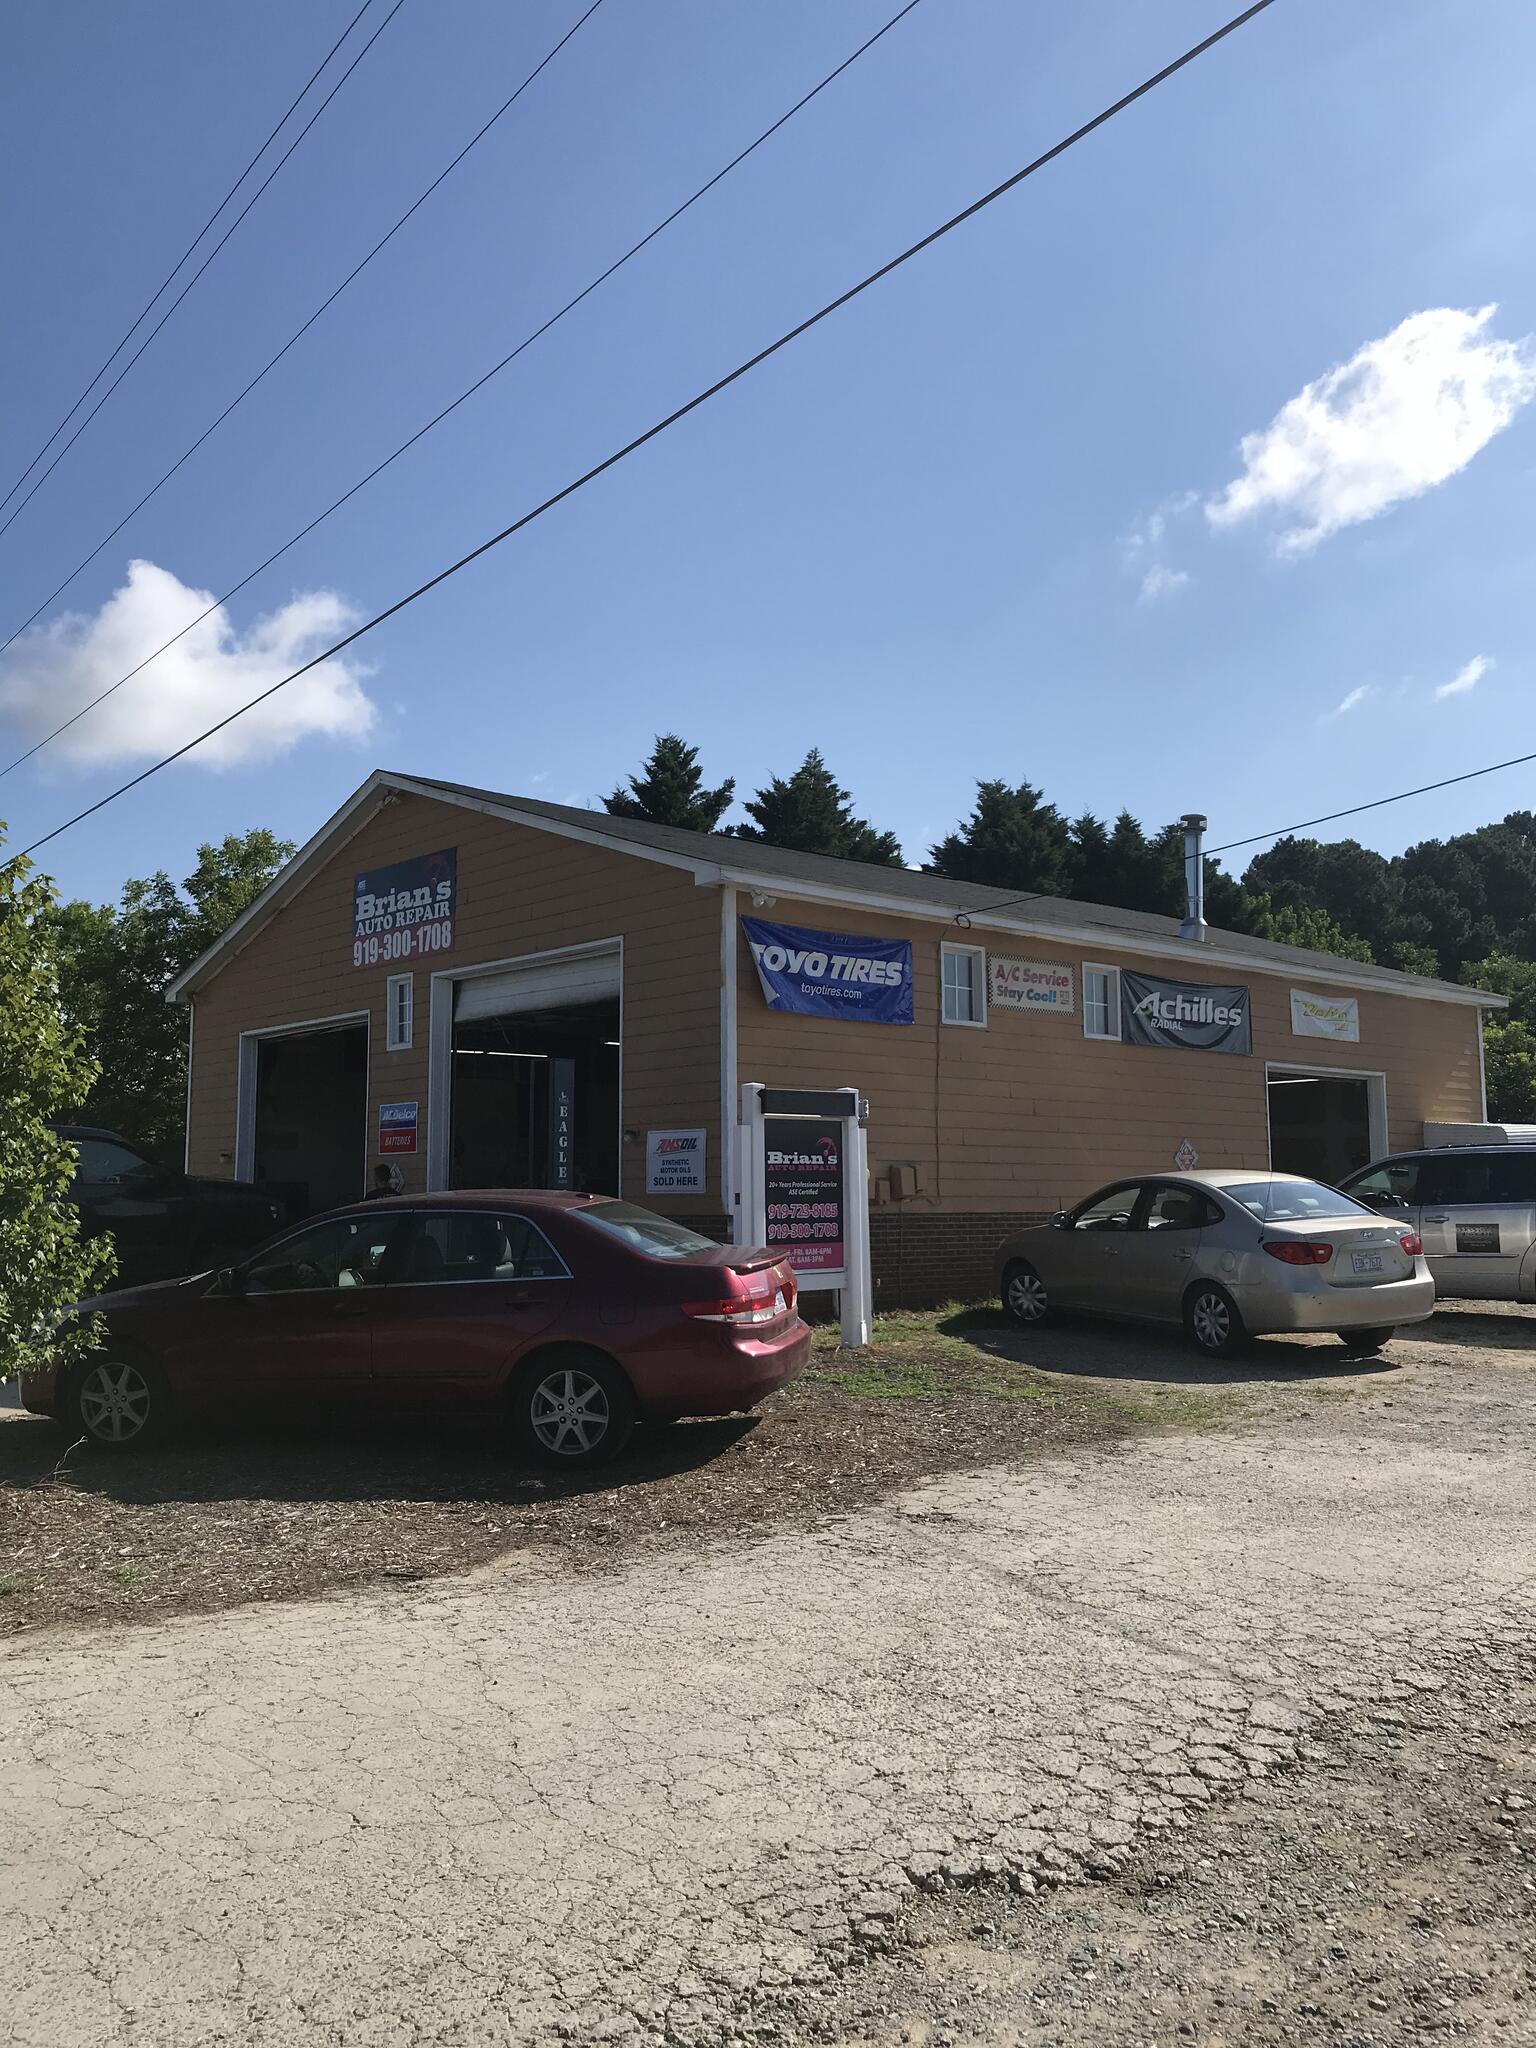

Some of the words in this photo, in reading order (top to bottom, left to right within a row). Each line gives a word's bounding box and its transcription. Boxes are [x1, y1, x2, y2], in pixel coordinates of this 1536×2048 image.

[355, 880, 452, 921] Brian's
[356, 915, 393, 937] AUTO
[396, 901, 451, 927] REPAIR
[353, 921, 452, 967] 919-300-1708
[749, 941, 828, 977] TOYO
[830, 955, 903, 986] TIRES
[995, 964, 1020, 983] A/C
[1022, 968, 1070, 987] Service
[801, 982, 862, 999] toyotires.com
[996, 985, 1025, 1002] Stay
[1132, 991, 1242, 1027] Achilles
[1150, 1018, 1183, 1031] RADIAL
[558, 1105, 568, 1178] EAGLE
[767, 1151, 838, 1165] Brian's
[679, 1166, 691, 1174] OILS
[653, 1176, 674, 1186] SOLD
[676, 1176, 698, 1186] HERE
[767, 1203, 839, 1219] 919-723-8185
[767, 1222, 839, 1239] 919-300-1708
